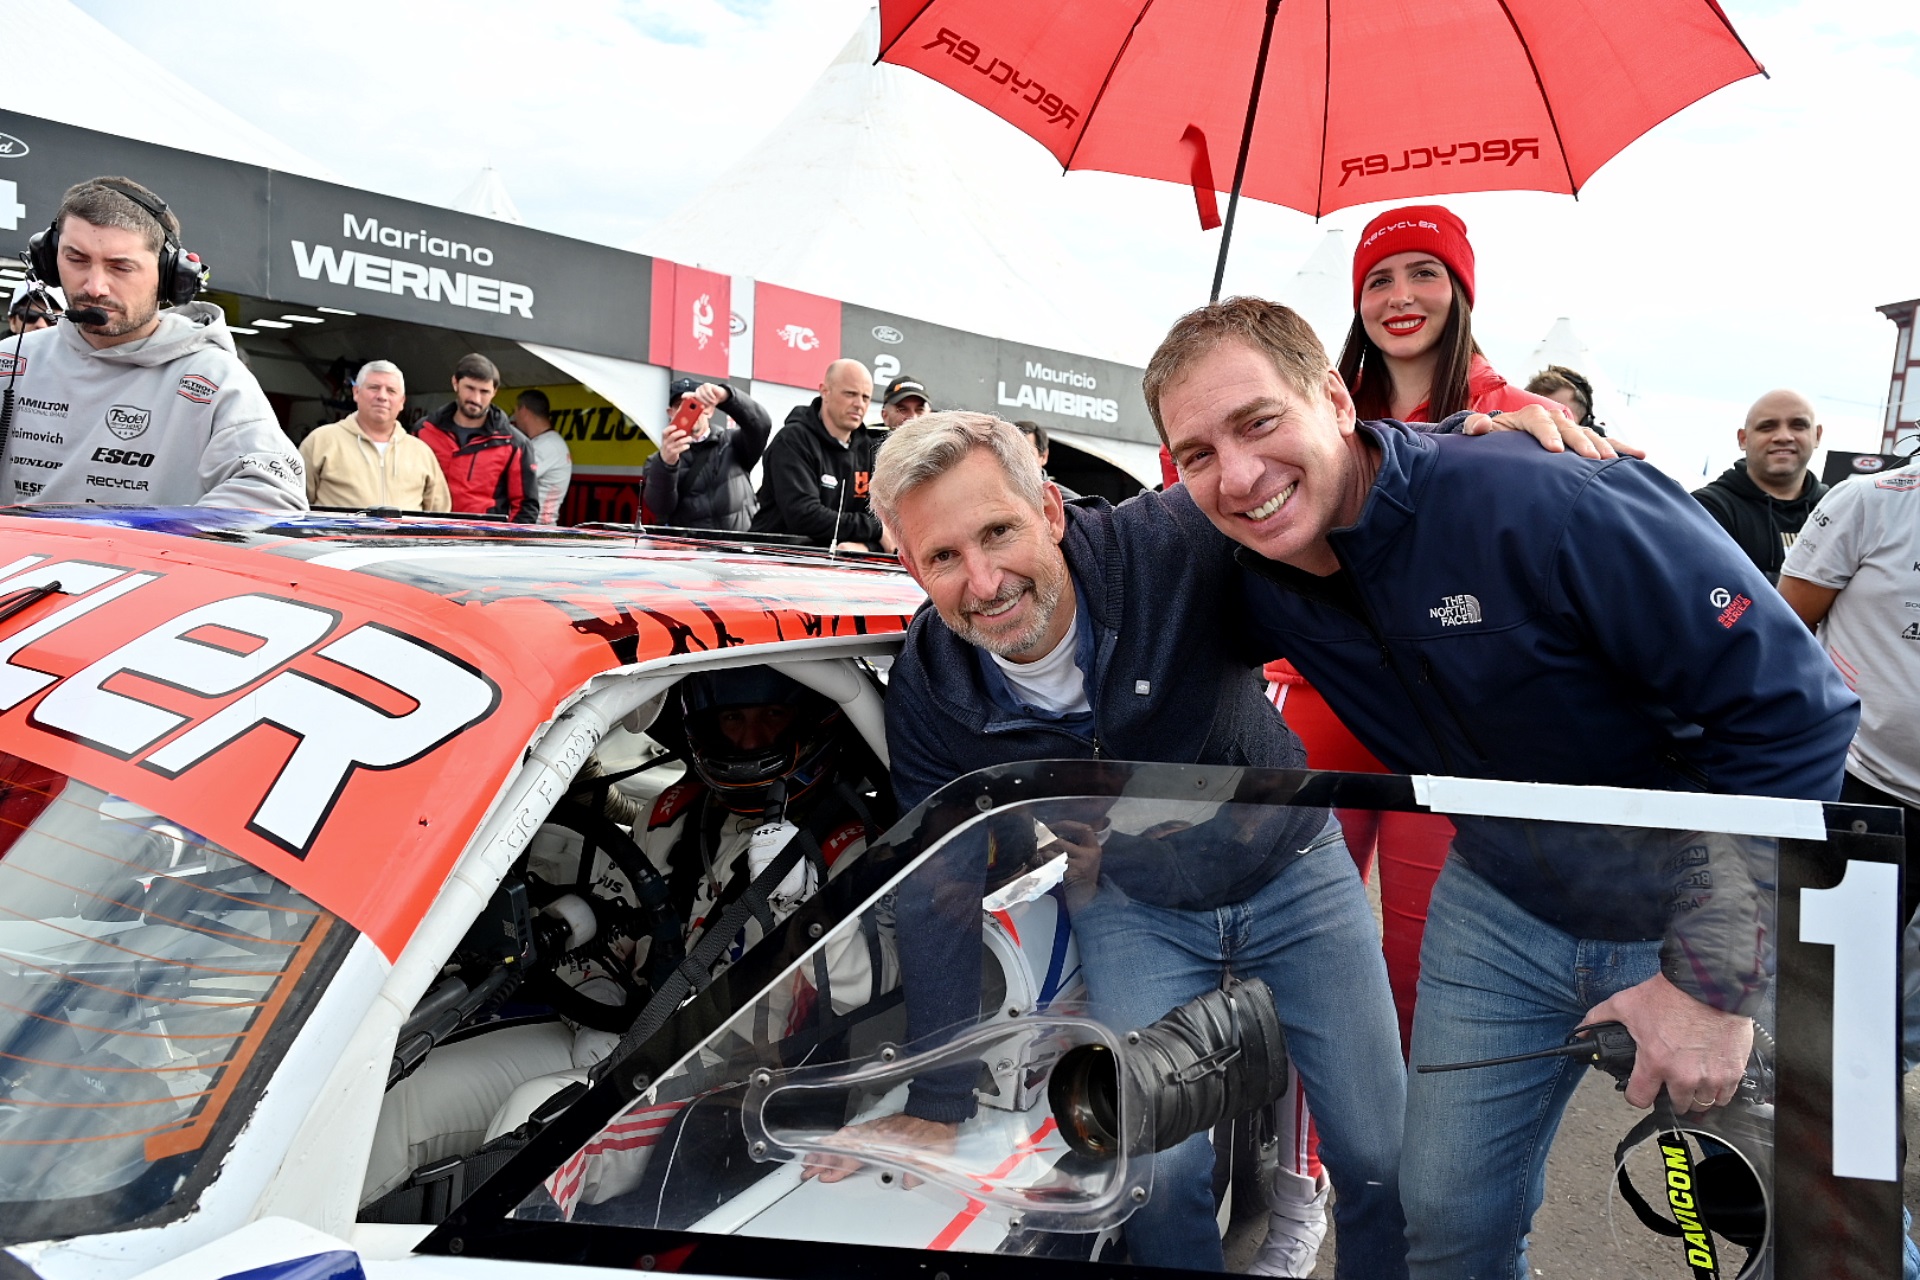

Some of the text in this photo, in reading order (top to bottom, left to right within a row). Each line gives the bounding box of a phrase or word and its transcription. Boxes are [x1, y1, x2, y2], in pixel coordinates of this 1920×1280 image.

[343, 213, 494, 267] Mariano
[290, 240, 534, 319] WERNER
[873, 354, 902, 386] 2
[1025, 361, 1097, 391] Mauricio
[109, 408, 148, 425] Fadel
[91, 447, 155, 468] ESCO
[86, 475, 149, 491] RECYCLER
[1429, 604, 1467, 618] NORTH
[1441, 595, 1465, 606] THE
[1724, 598, 1751, 628] SERIES
[1441, 614, 1468, 627] FACE
[1799, 859, 1899, 1182] 1
[1661, 1145, 1714, 1270] DAVICOM
